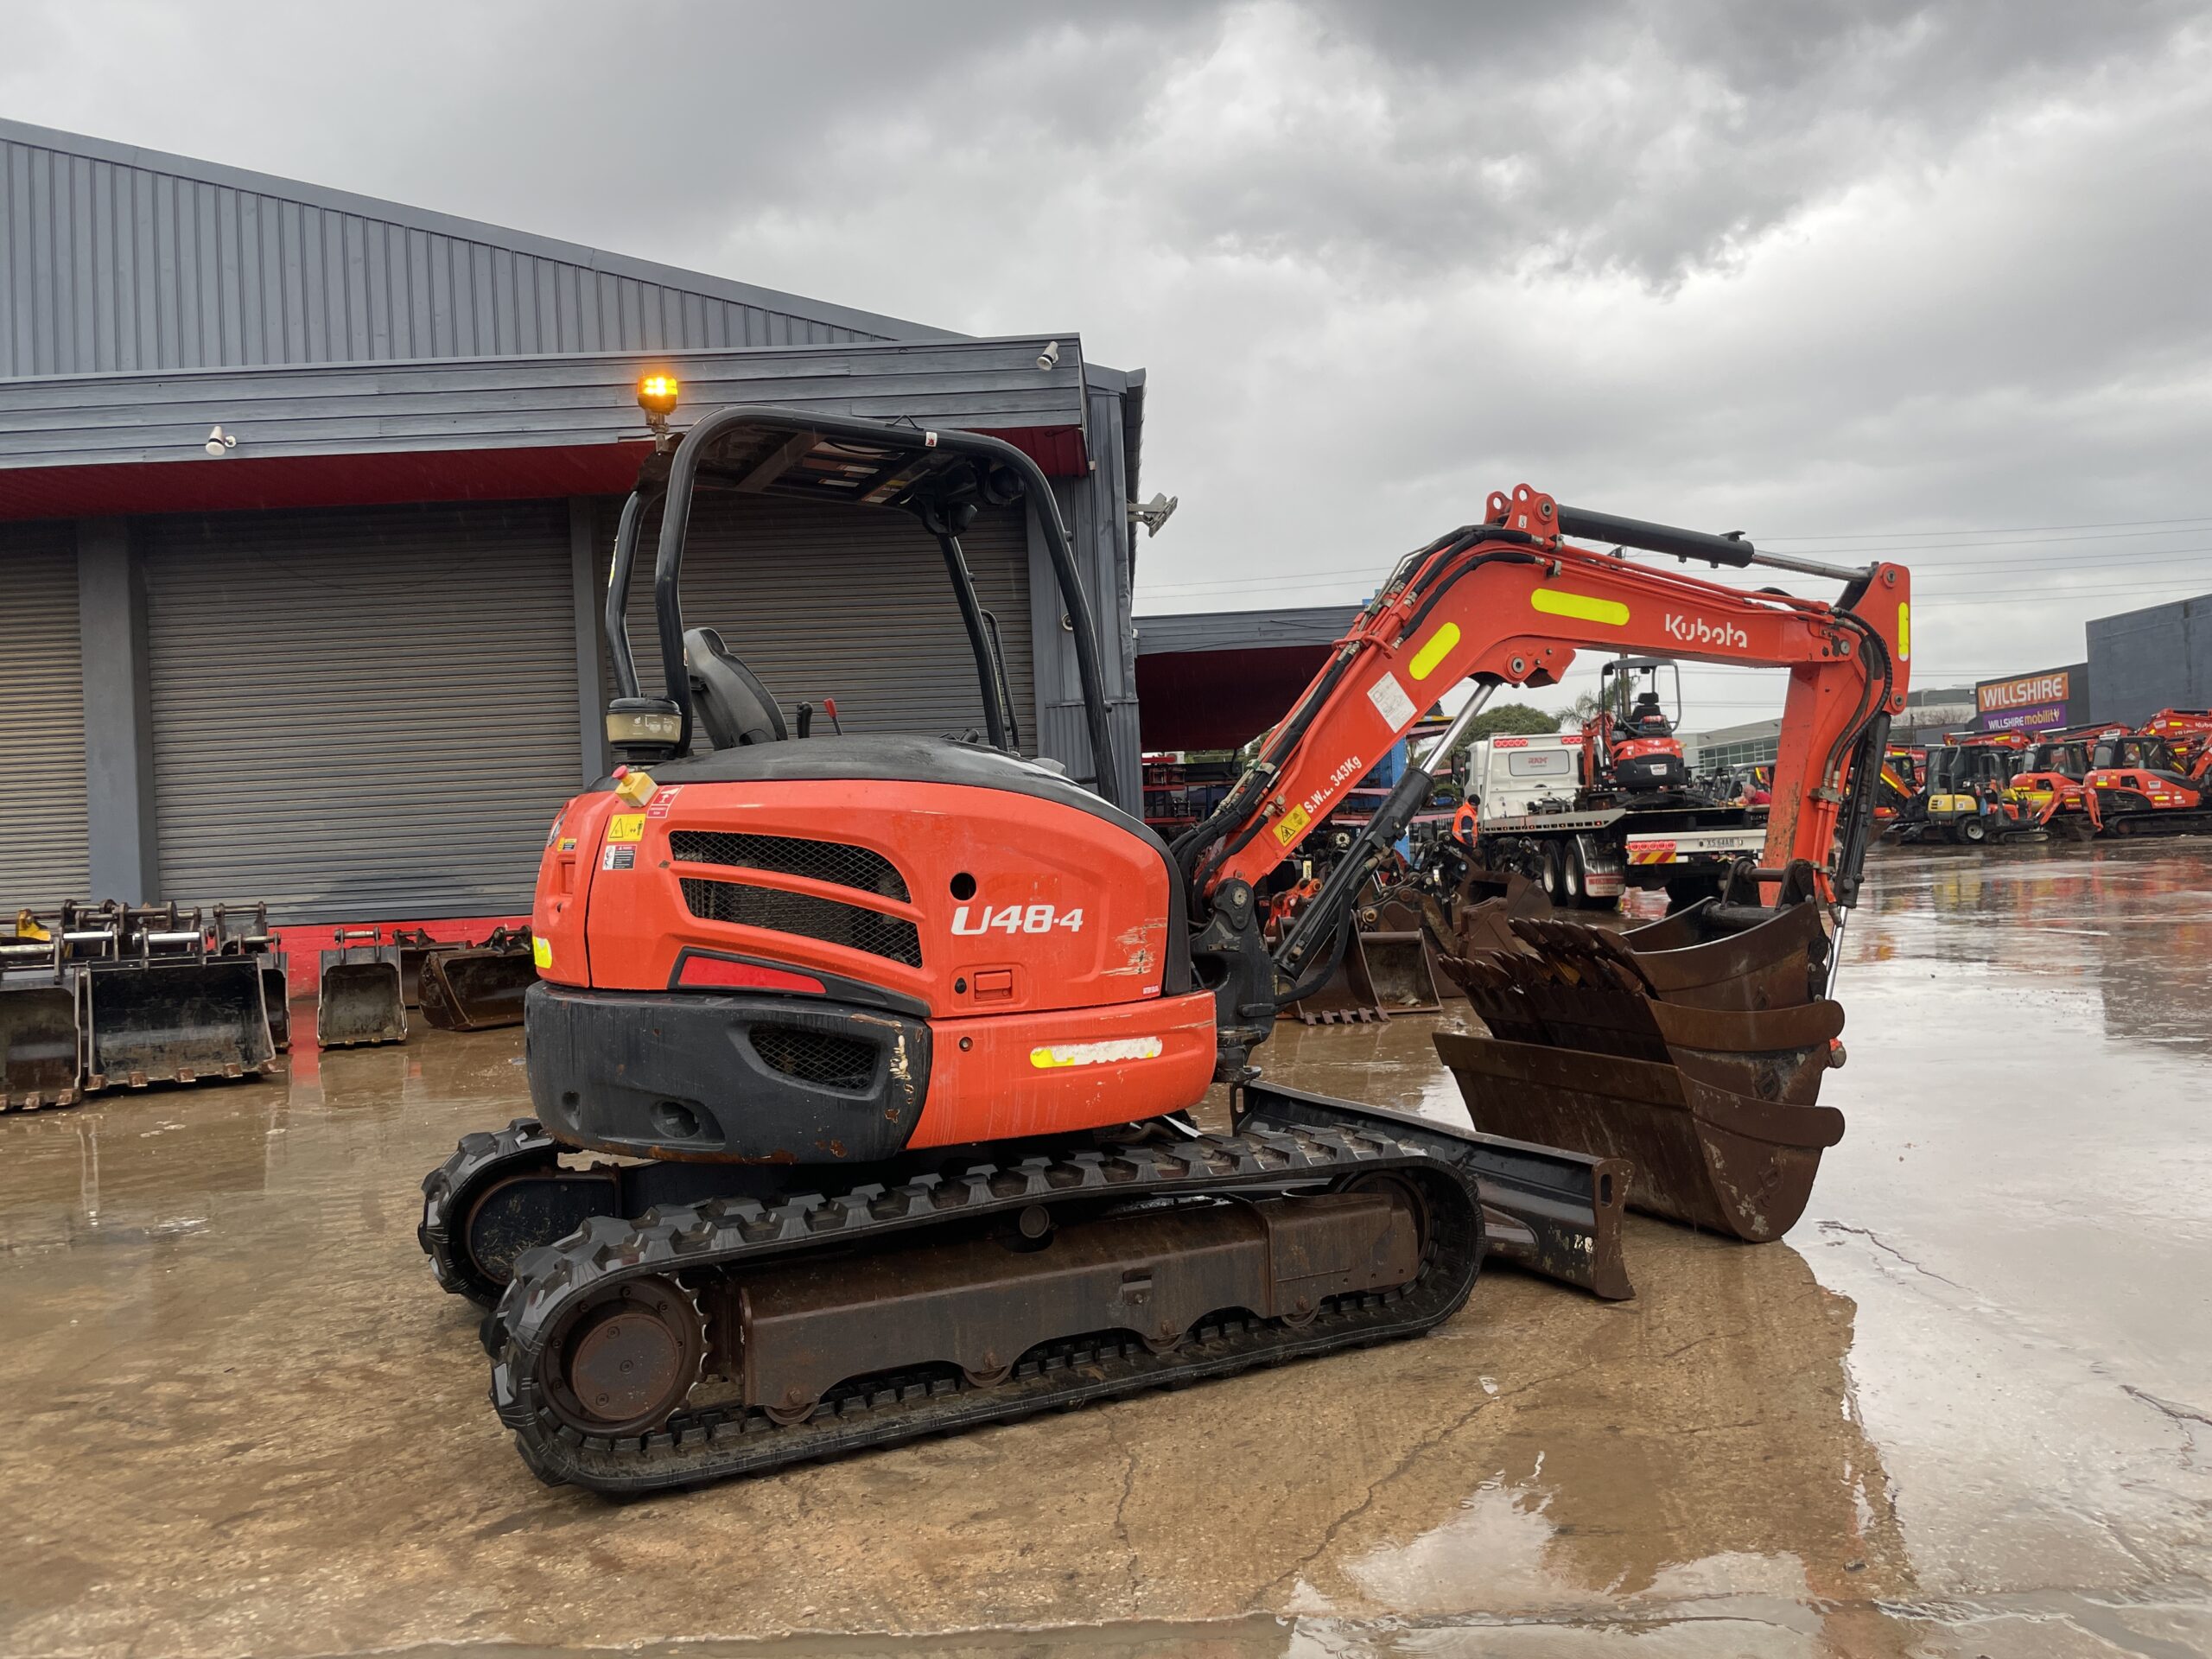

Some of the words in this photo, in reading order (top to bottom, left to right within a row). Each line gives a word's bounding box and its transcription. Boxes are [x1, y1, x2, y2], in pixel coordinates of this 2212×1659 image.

[1664, 613, 1747, 648] Kubota
[1982, 677, 2063, 708] WILLSHIRE
[1987, 716, 2024, 730] WILLSHIRE
[1331, 755, 1363, 787] 343Kg
[951, 905, 1084, 935] U48-4
